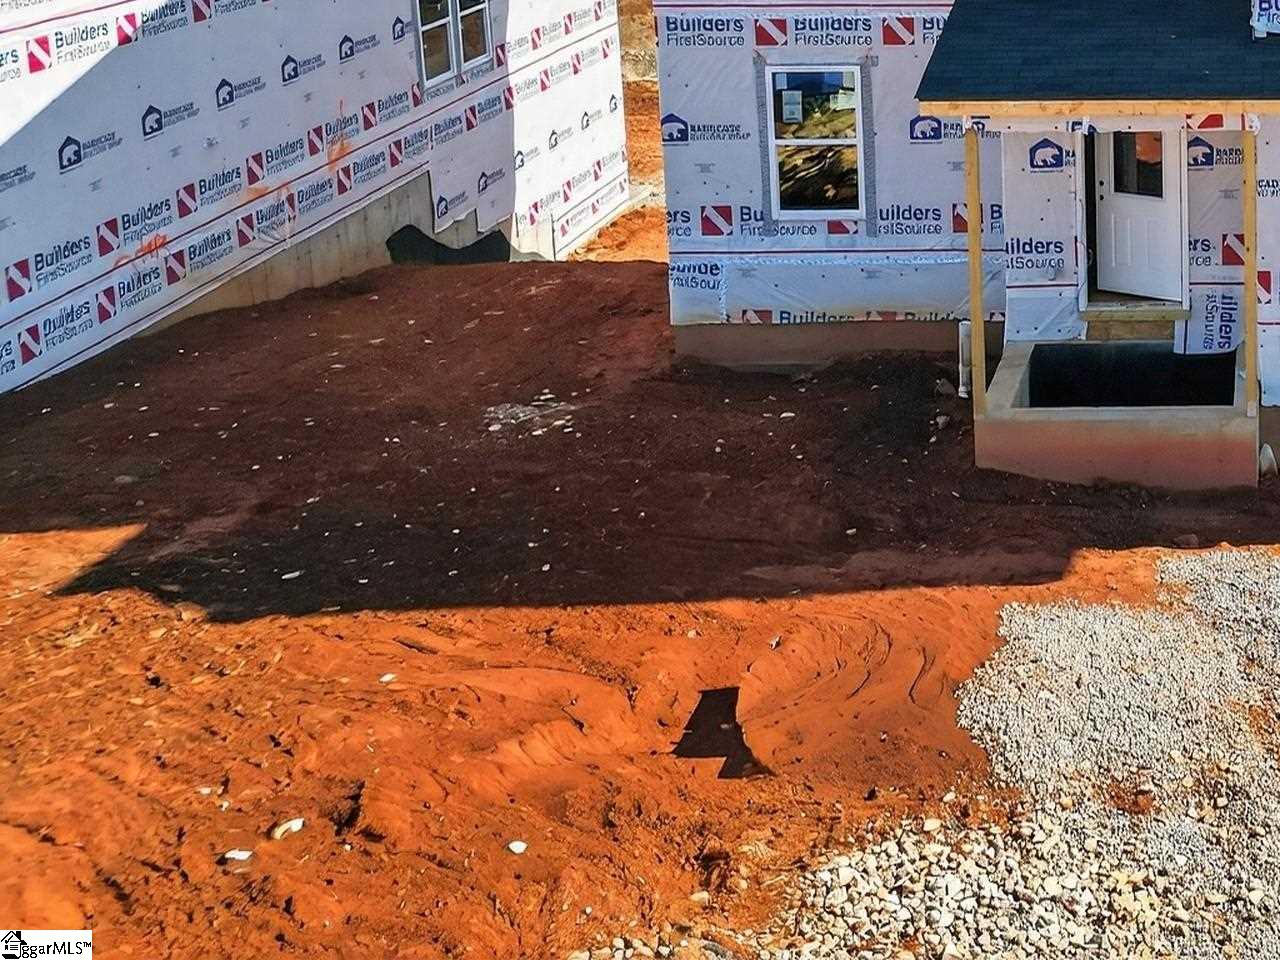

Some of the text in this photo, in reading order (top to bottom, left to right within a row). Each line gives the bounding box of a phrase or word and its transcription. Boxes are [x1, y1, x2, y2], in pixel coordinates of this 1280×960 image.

[55, 22, 109, 48] Builders
[666, 16, 744, 32] Builders
[666, 32, 744, 46] FirstSource
[794, 32, 872, 47] FirstSource
[198, 171, 241, 197] Builders
[121, 198, 171, 230] Builders
[878, 203, 942, 221] uilders
[35, 235, 91, 271] Builders
[187, 227, 233, 260] Builders
